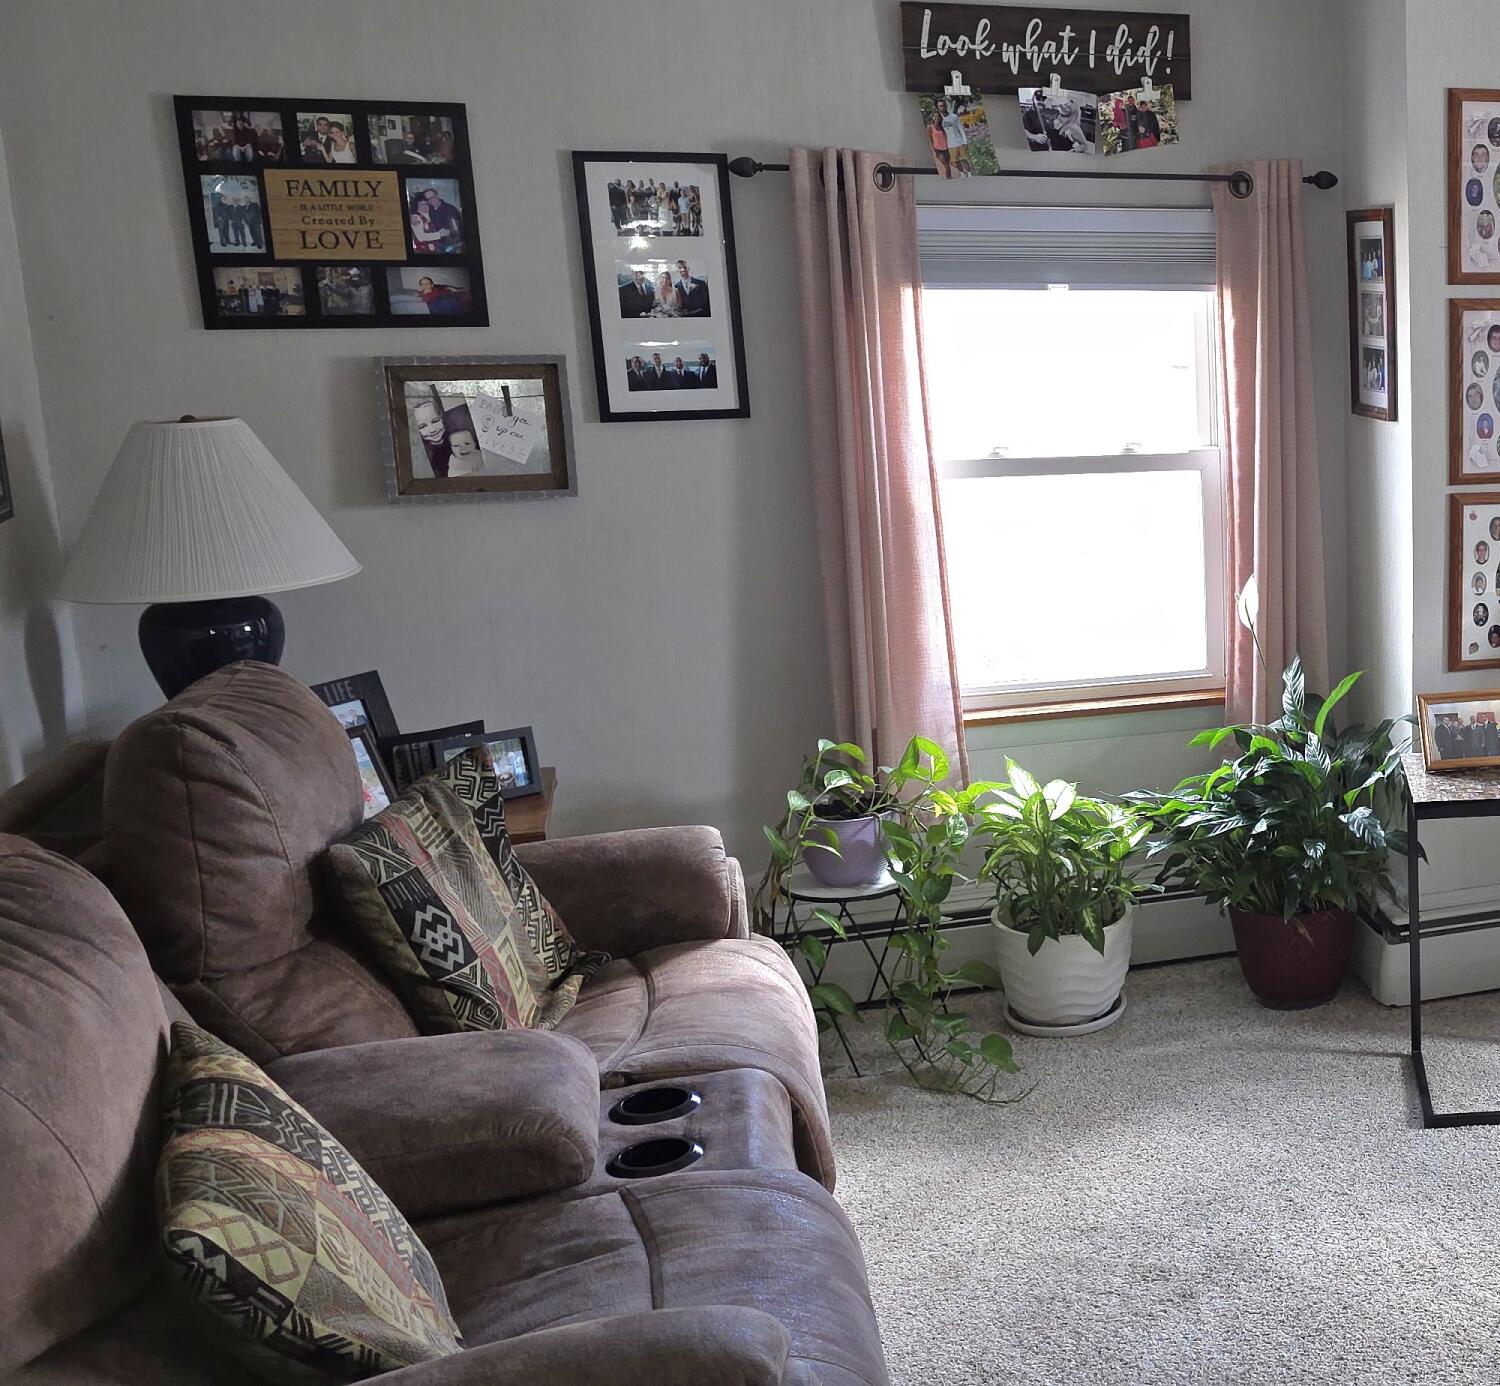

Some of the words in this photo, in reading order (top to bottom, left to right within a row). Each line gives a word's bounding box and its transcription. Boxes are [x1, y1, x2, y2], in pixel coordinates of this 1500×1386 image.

[920, 8, 996, 60] Look
[1001, 18, 1080, 75] what
[1088, 29, 1097, 69] I
[285, 179, 382, 198] FAMILY
[301, 213, 355, 226] Created
[359, 215, 376, 228] By
[299, 230, 384, 250] LOVE
[323, 680, 355, 704] LIFE
